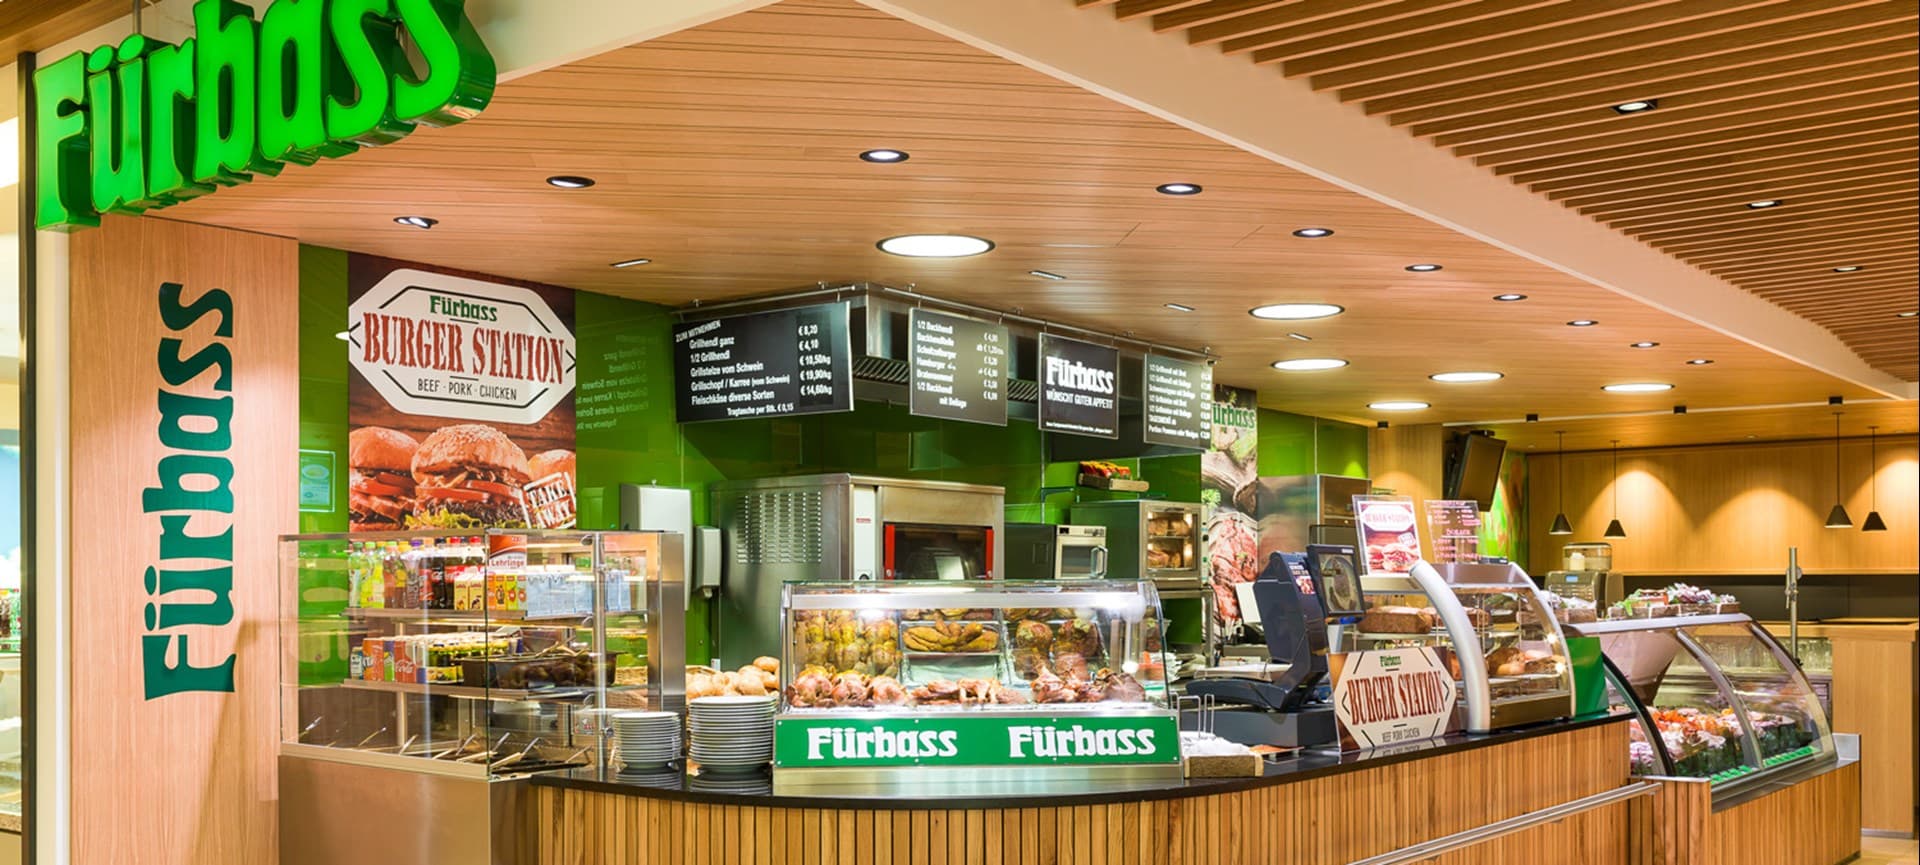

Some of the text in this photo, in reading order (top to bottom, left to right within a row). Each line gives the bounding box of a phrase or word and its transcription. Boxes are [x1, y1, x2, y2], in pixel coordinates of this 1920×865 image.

[33, 0, 480, 230] Fürbass
[429, 295, 498, 322] Fürbass
[363, 312, 564, 384] BURGER STATION
[689, 337, 735, 349] Grillhendl ganz
[700, 350, 731, 362] Grillhendl
[721, 365, 736, 375] vom
[736, 361, 764, 373] Schwein
[1046, 356, 1114, 394] Fürbass
[418, 378, 518, 401] BEEF PORK CHICKEN
[728, 391, 751, 402] diverse
[752, 390, 775, 401] Sorten
[1046, 389, 1074, 403] WÜNSCHT
[1074, 393, 1093, 406] GUTEN
[1212, 402, 1255, 429] ürbass
[142, 281, 237, 700] Fürbass
[528, 480, 567, 508] TAKE
[536, 500, 571, 528] AWAY
[491, 558, 525, 568] Lehrlinge
[1347, 670, 1445, 725] BURGER STATION
[807, 726, 958, 760] Fürbass
[1008, 725, 1156, 758] Fürbass
